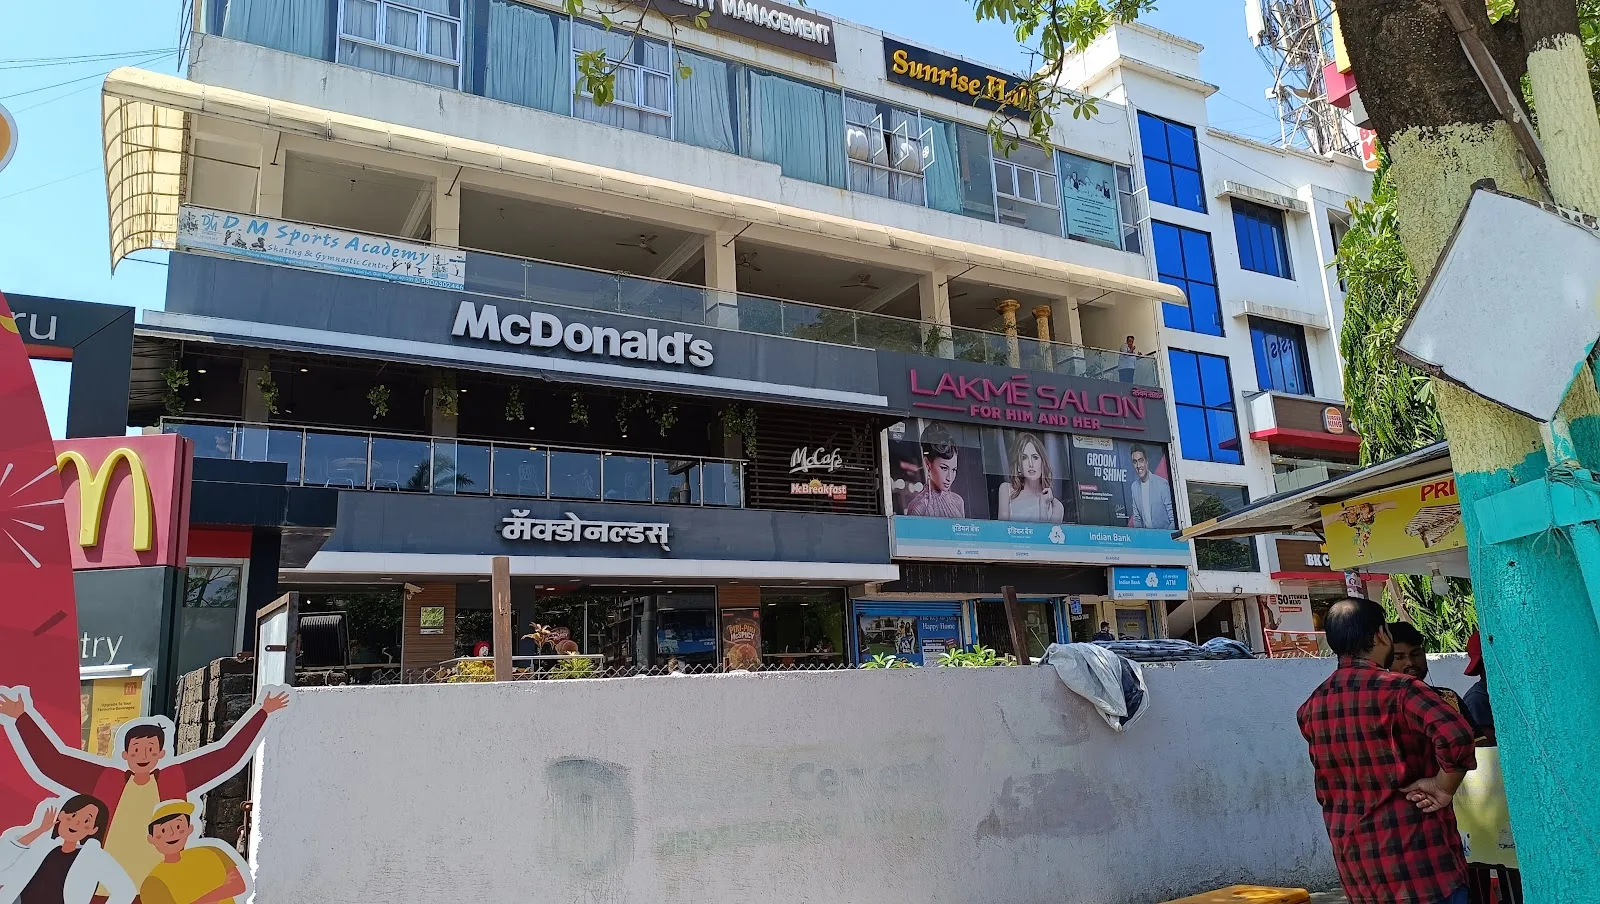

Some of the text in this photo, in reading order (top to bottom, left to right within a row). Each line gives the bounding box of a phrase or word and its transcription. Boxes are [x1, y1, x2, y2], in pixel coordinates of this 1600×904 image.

[722, 0, 830, 46] MANAGEMENT
[893, 49, 981, 96] Sunrise
[275, 225, 339, 248] Sports
[345, 236, 429, 266] Academy
[267, 244, 302, 258] Skating
[304, 250, 313, 258] &
[315, 251, 360, 266] Gymnastic
[362, 259, 390, 270] Centre
[451, 300, 714, 367] McDonald's
[910, 368, 1145, 420] LAKMÉ SALON
[970, 403, 1101, 431] FOR HIM AND HER
[1328, 420, 1342, 428] KING
[1086, 452, 1117, 468] GROOM
[1094, 466, 1127, 482] TO SHINE
[790, 482, 847, 497] McBreakfast
[1420, 478, 1456, 502] PRI
[1089, 532, 1132, 542] Indian Bank
[1304, 553, 1322, 566] BK
[1277, 595, 1288, 605] 50
[729, 623, 756, 634] PIRI-PIRI
[922, 622, 955, 631] Happy Home
[730, 631, 755, 641] McSPICY
